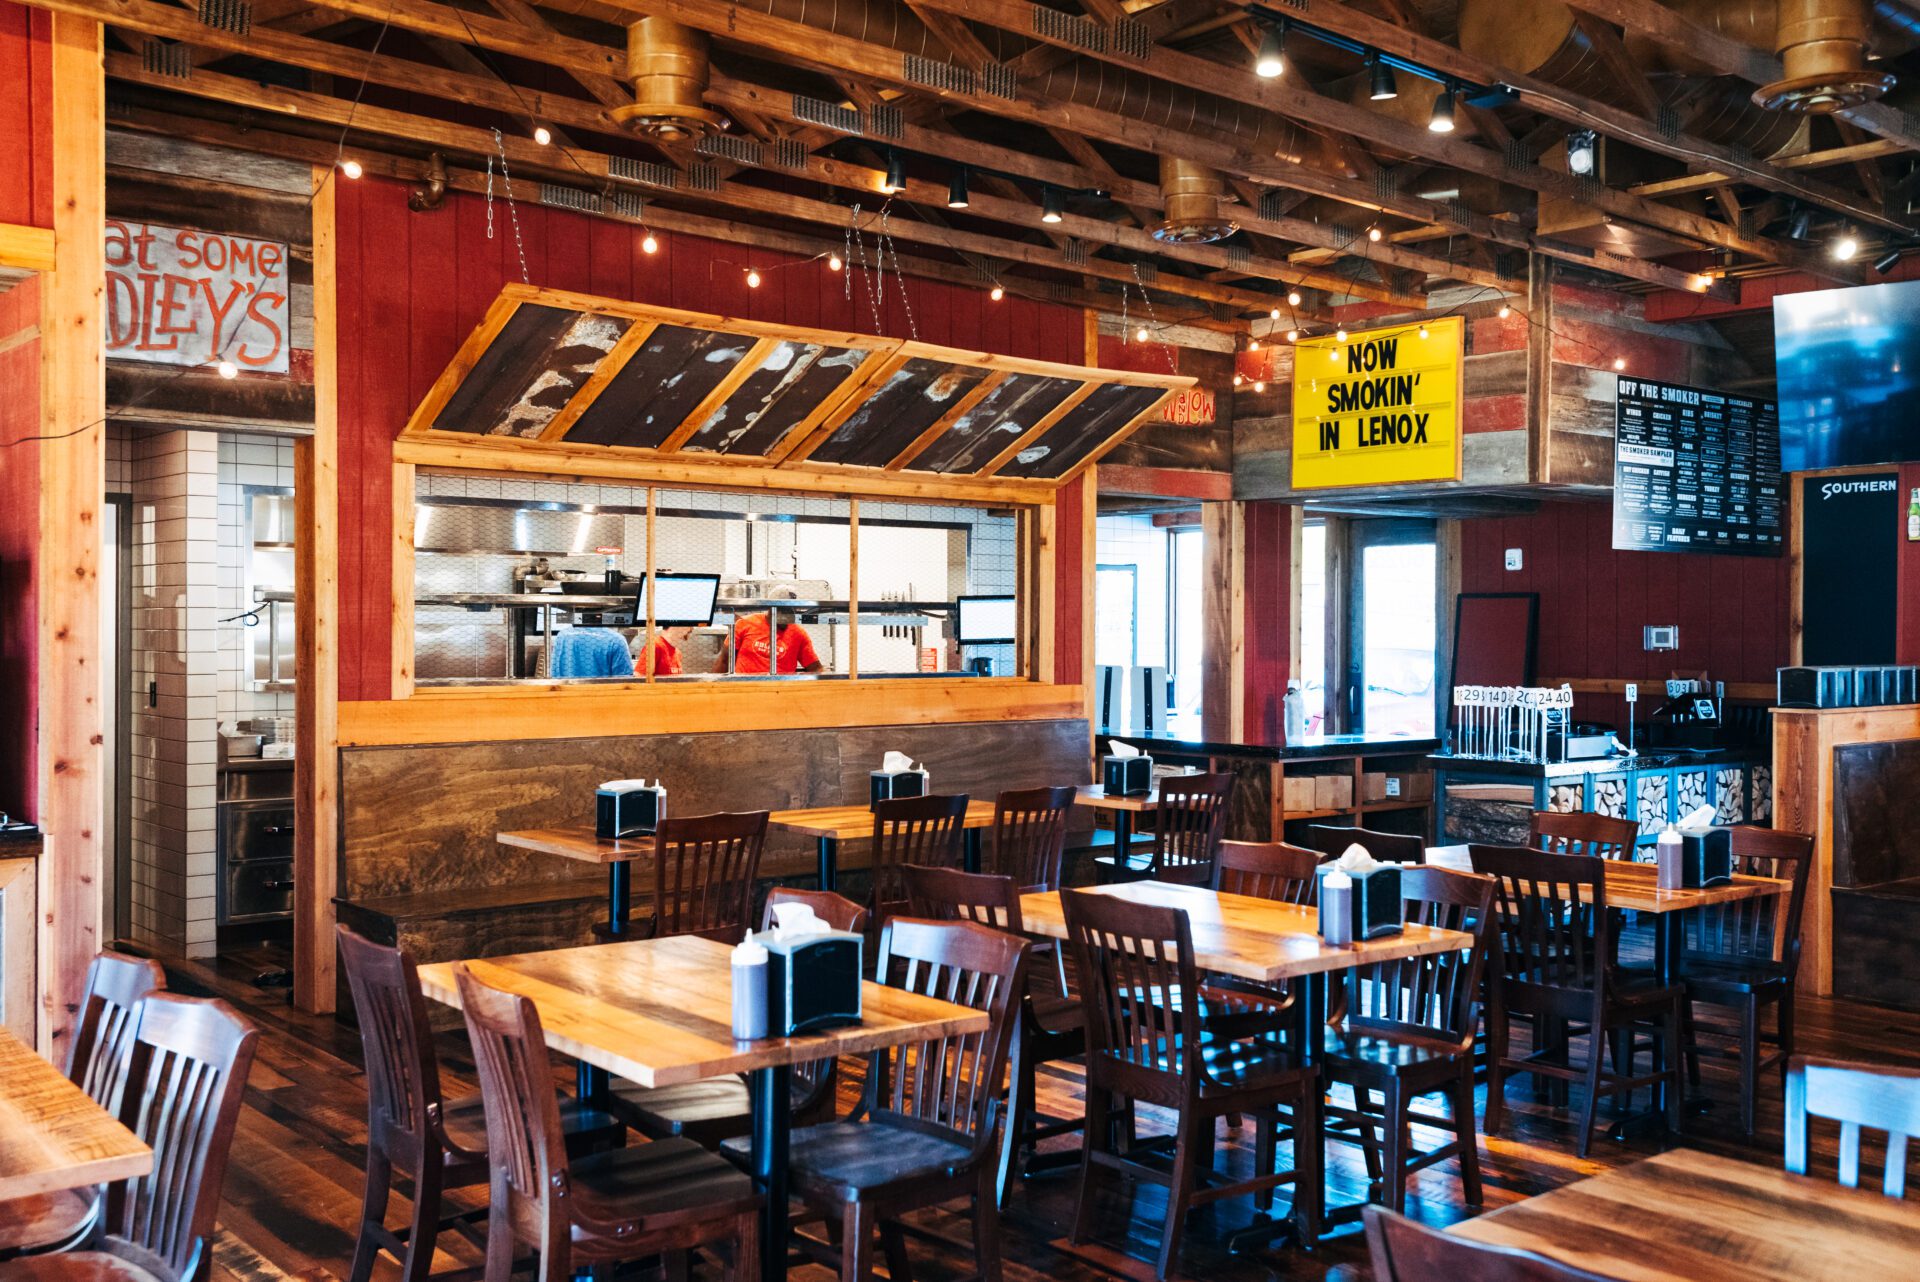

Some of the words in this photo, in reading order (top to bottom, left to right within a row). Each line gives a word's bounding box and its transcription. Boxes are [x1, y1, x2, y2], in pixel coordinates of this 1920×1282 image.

[1348, 338, 1397, 373] NOW
[1328, 373, 1421, 413] SMOKIN'
[1619, 380, 1637, 395] OFF
[1640, 383, 1658, 399] THE
[1661, 387, 1700, 405] SMOKER
[1319, 421, 1340, 451] IN
[1358, 413, 1430, 447] LENOX
[1630, 447, 1649, 455] SMOKER
[1651, 449, 1672, 458] SAMPLER
[1821, 479, 1897, 500] SOUTHERN
[1464, 689, 1480, 701] 29
[1539, 692, 1552, 704] 24
[1556, 692, 1571, 703] 40
